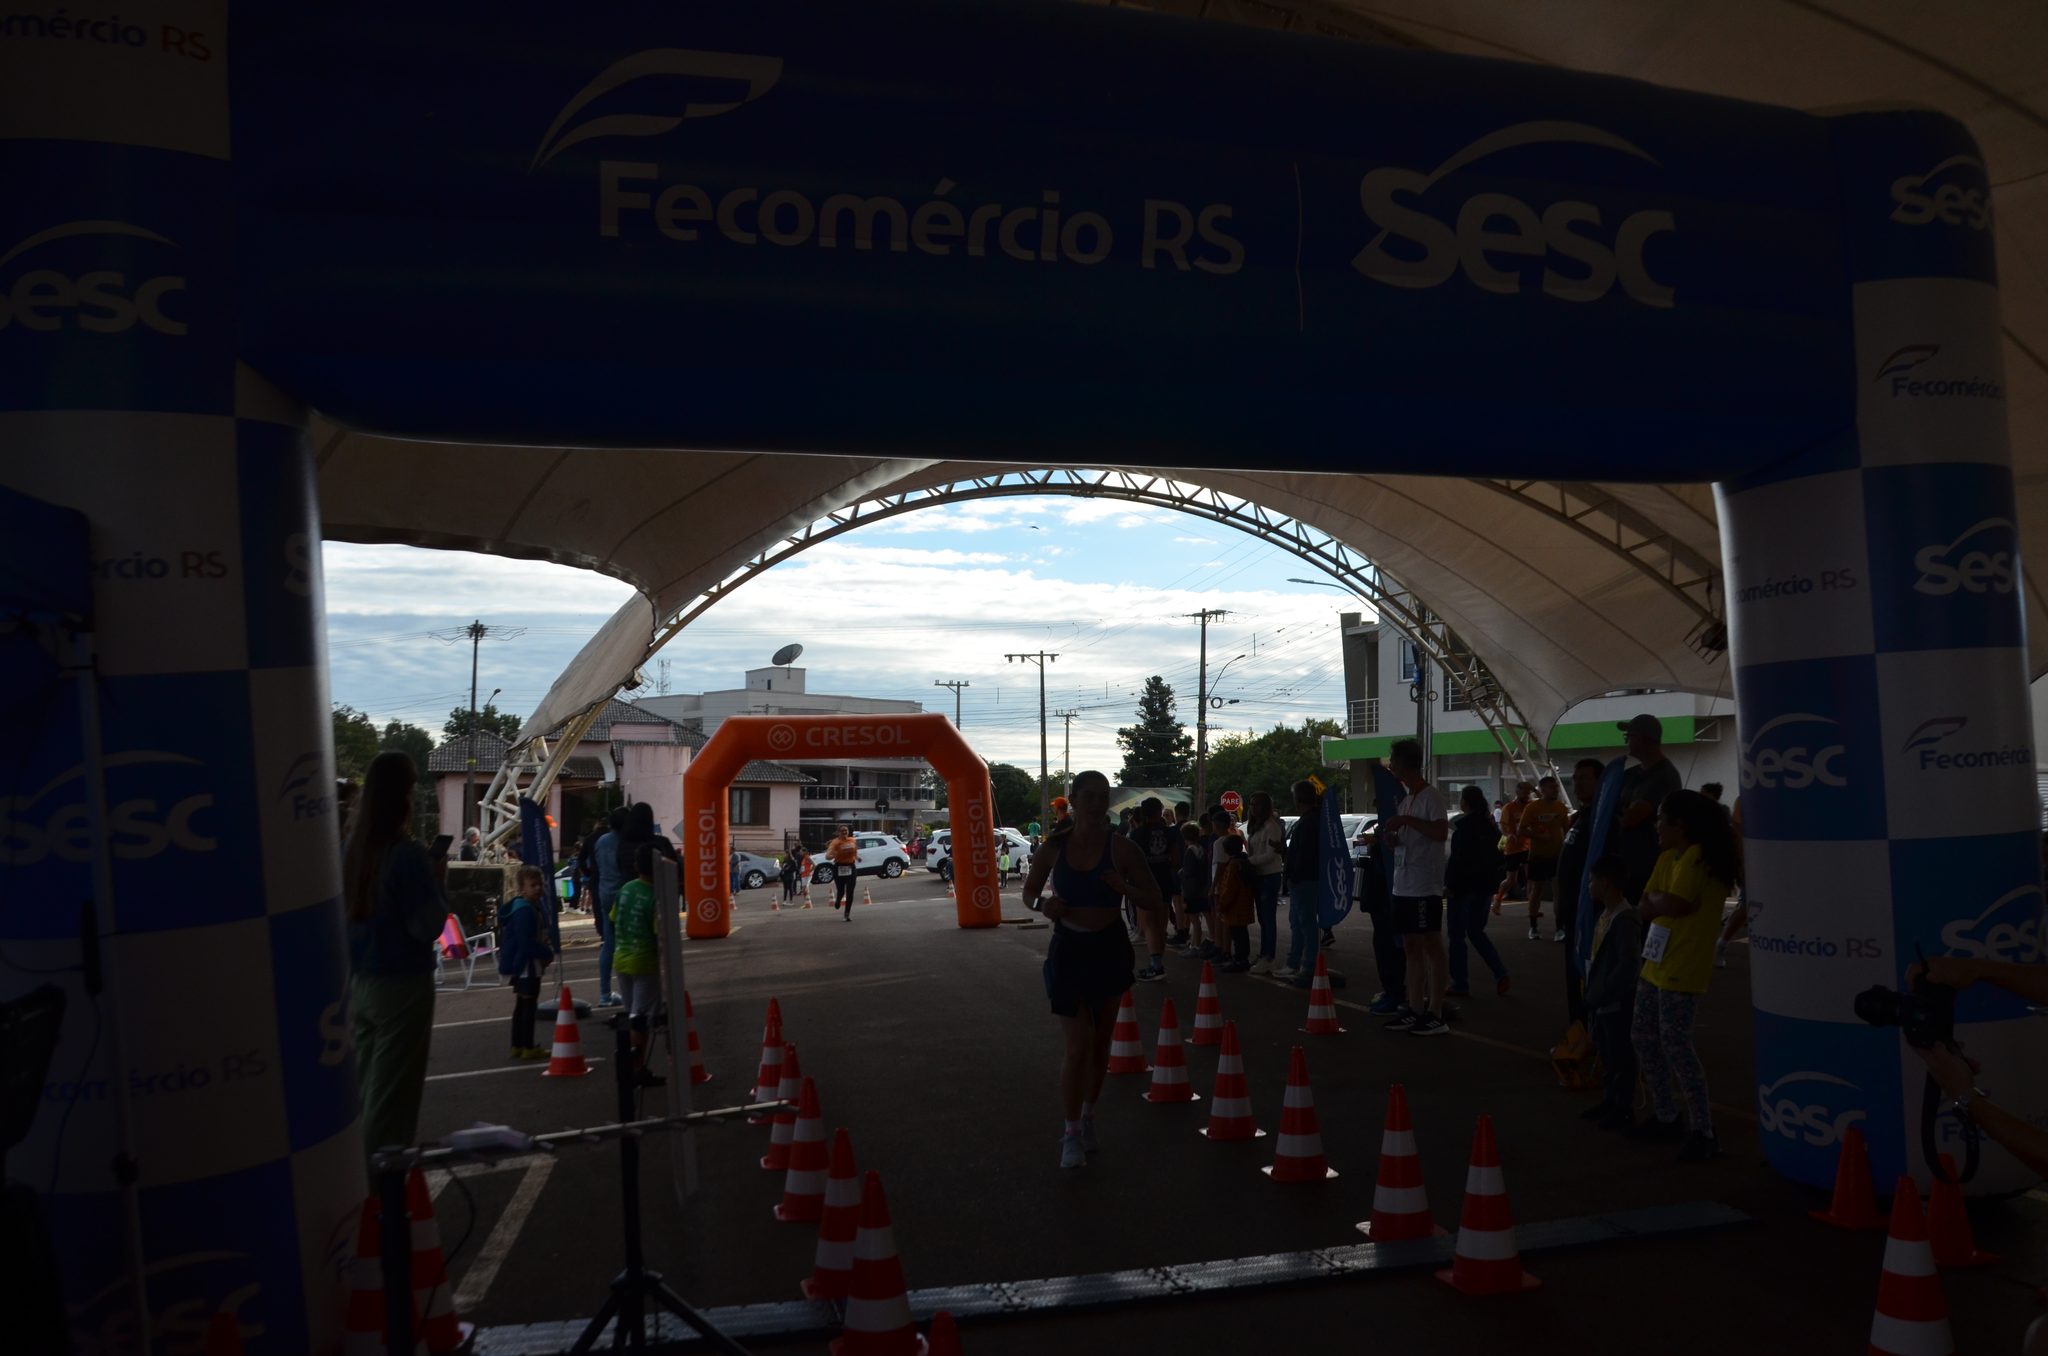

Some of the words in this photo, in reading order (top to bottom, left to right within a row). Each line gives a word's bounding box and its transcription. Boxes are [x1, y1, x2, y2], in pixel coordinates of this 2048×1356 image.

[0, 8, 147, 48] mércio
[161, 24, 212, 62] RS
[599, 160, 1114, 266] Fecomércio
[1141, 199, 1246, 275] RS
[1889, 174, 1996, 231] Ses
[1351, 166, 1676, 309] Sesc
[0, 268, 189, 336] esc
[181, 550, 228, 579] RS
[1820, 568, 1858, 591] RS
[1912, 543, 2018, 596] Ses
[805, 724, 911, 748] CRESOL
[1222, 797, 1240, 805] PARE
[699, 800, 717, 893] CRESOL
[968, 791, 989, 879] CRESOL
[1845, 937, 1883, 958] RS
[1941, 918, 2048, 963] Ses
